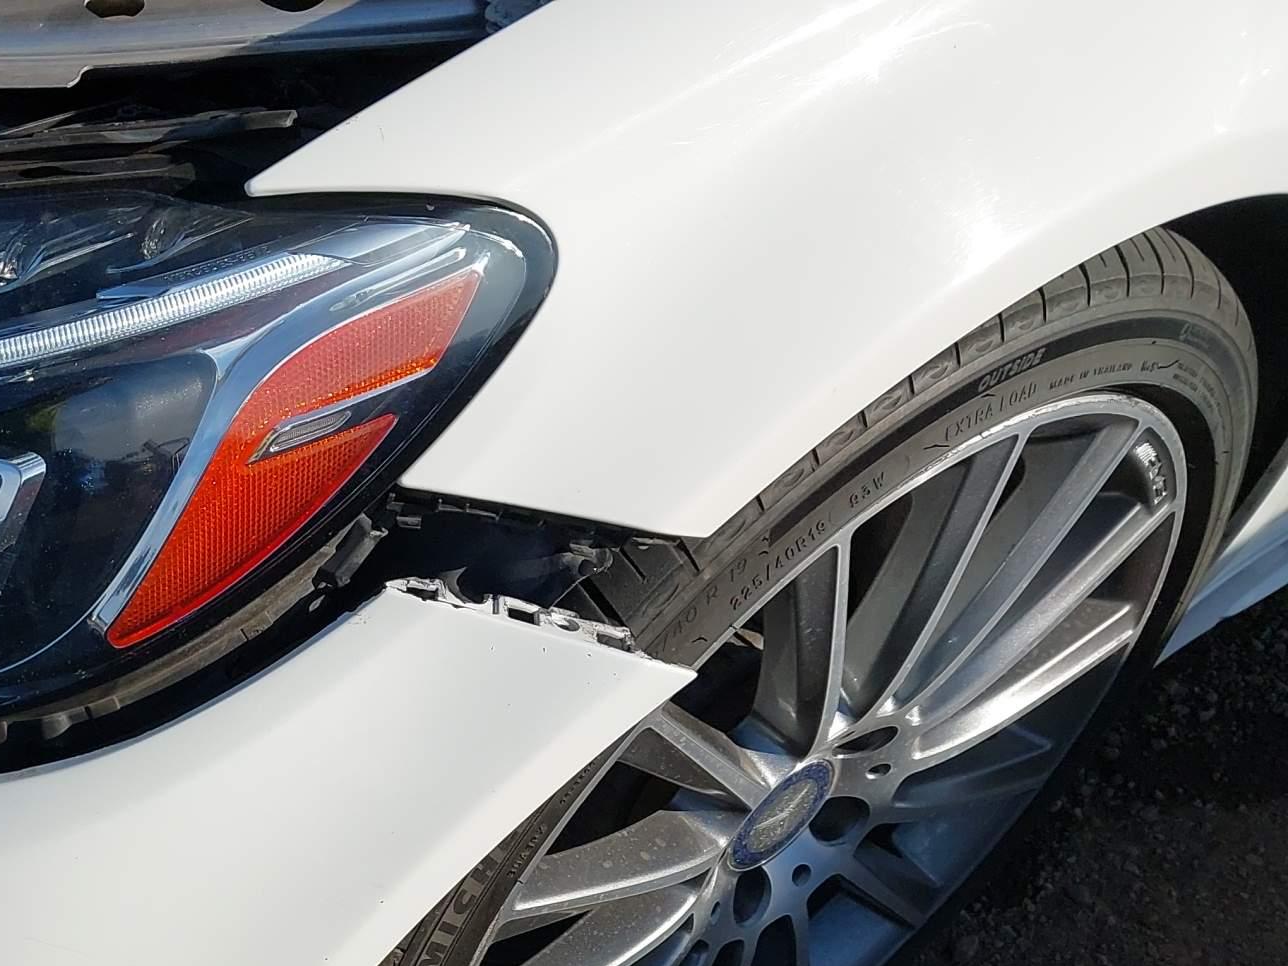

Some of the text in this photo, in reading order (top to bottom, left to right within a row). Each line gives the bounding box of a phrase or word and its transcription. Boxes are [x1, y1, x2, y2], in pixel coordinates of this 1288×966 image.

[978, 347, 1046, 393] OUTSIDE
[1049, 374, 1075, 390] MADE
[944, 381, 1038, 442] EXTRA LOAD
[728, 519, 826, 611] 225/40R19
